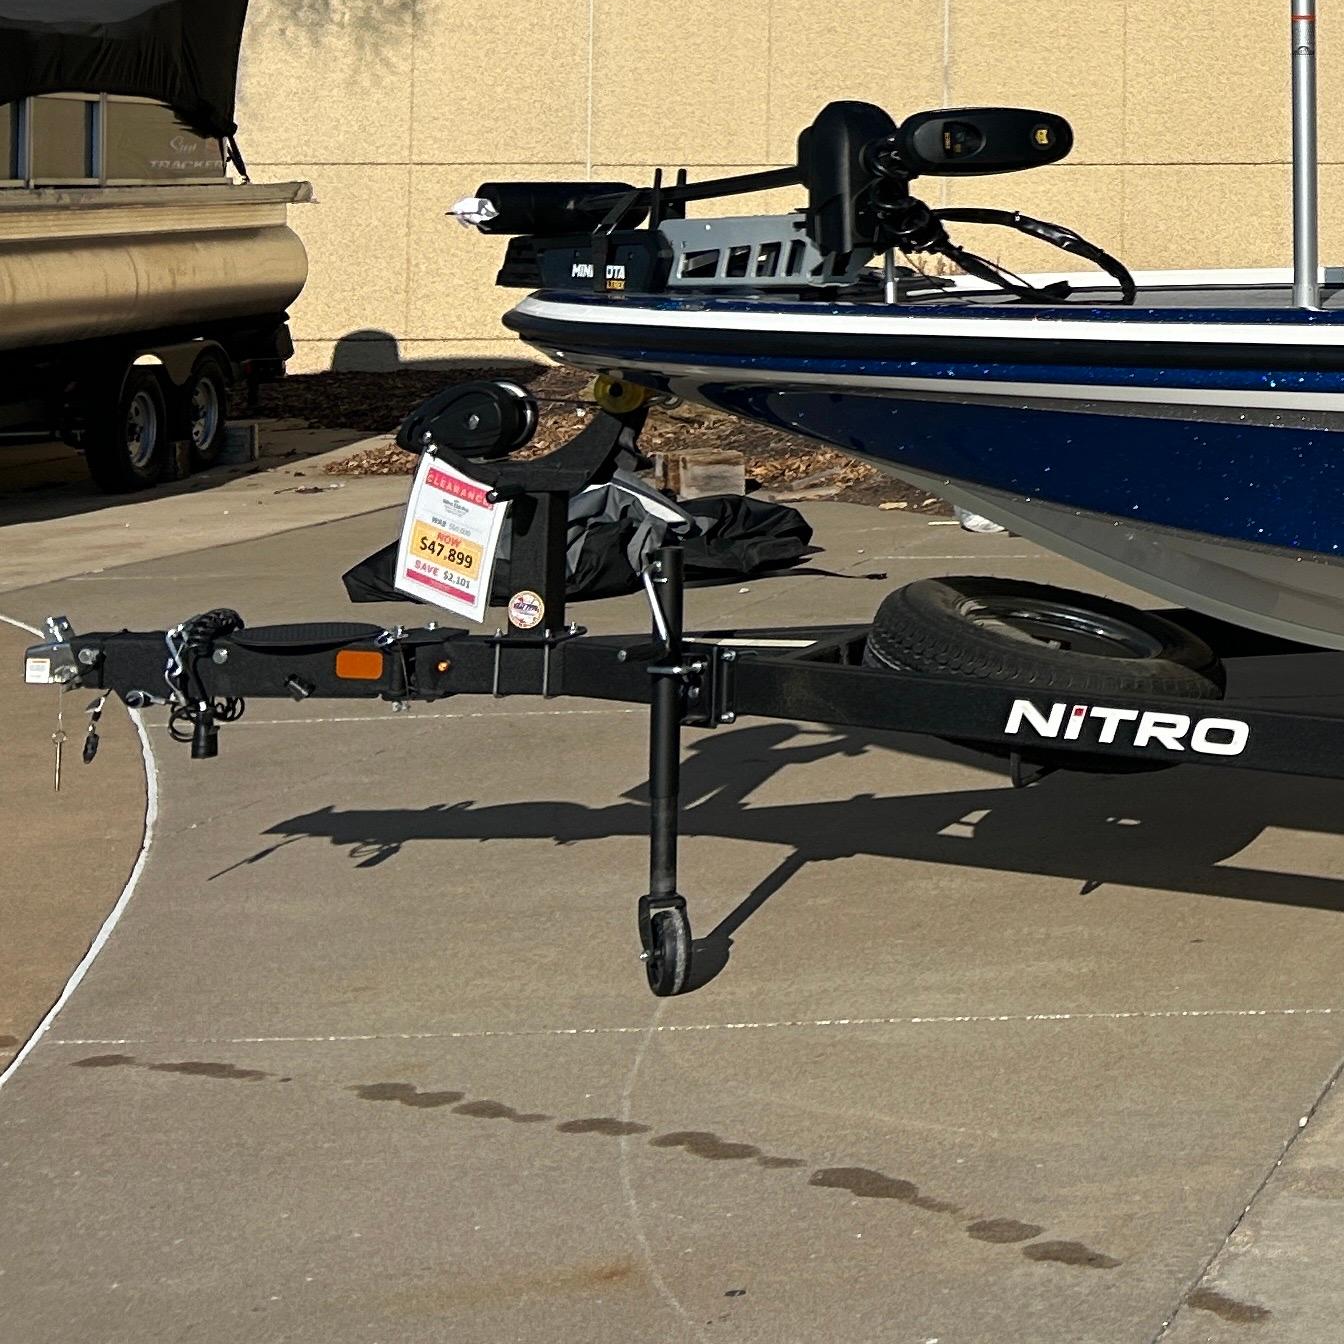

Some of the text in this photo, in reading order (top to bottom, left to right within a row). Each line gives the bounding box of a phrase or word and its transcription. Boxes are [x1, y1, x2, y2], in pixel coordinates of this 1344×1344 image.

[606, 265, 626, 279] OTA
[425, 469, 494, 511] CLEARANCE
[436, 531, 463, 549] NOW
[419, 535, 473, 569] $47,899
[414, 559, 440, 577] SAVE
